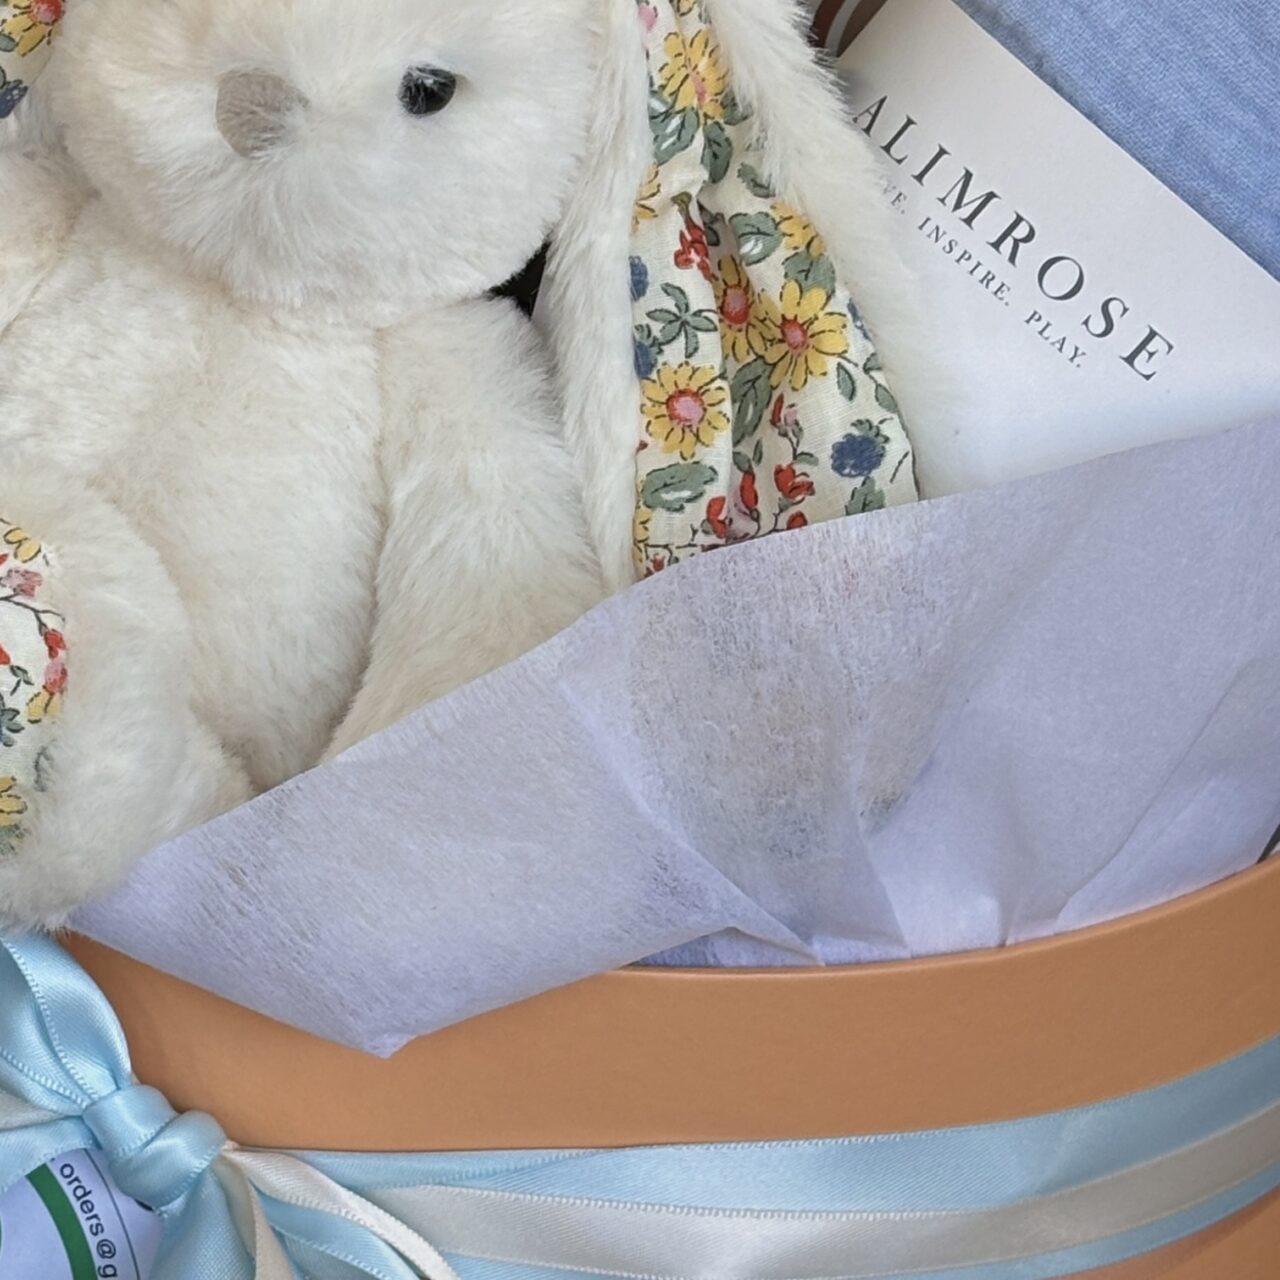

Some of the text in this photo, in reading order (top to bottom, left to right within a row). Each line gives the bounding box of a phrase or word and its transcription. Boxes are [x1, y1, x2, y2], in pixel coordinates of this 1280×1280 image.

[852, 95, 1174, 381] ALIMROSE
[918, 216, 1010, 306] INSPIRE.
[1024, 310, 1087, 368] PLAY.
[60, 1163, 118, 1278] orders@g
